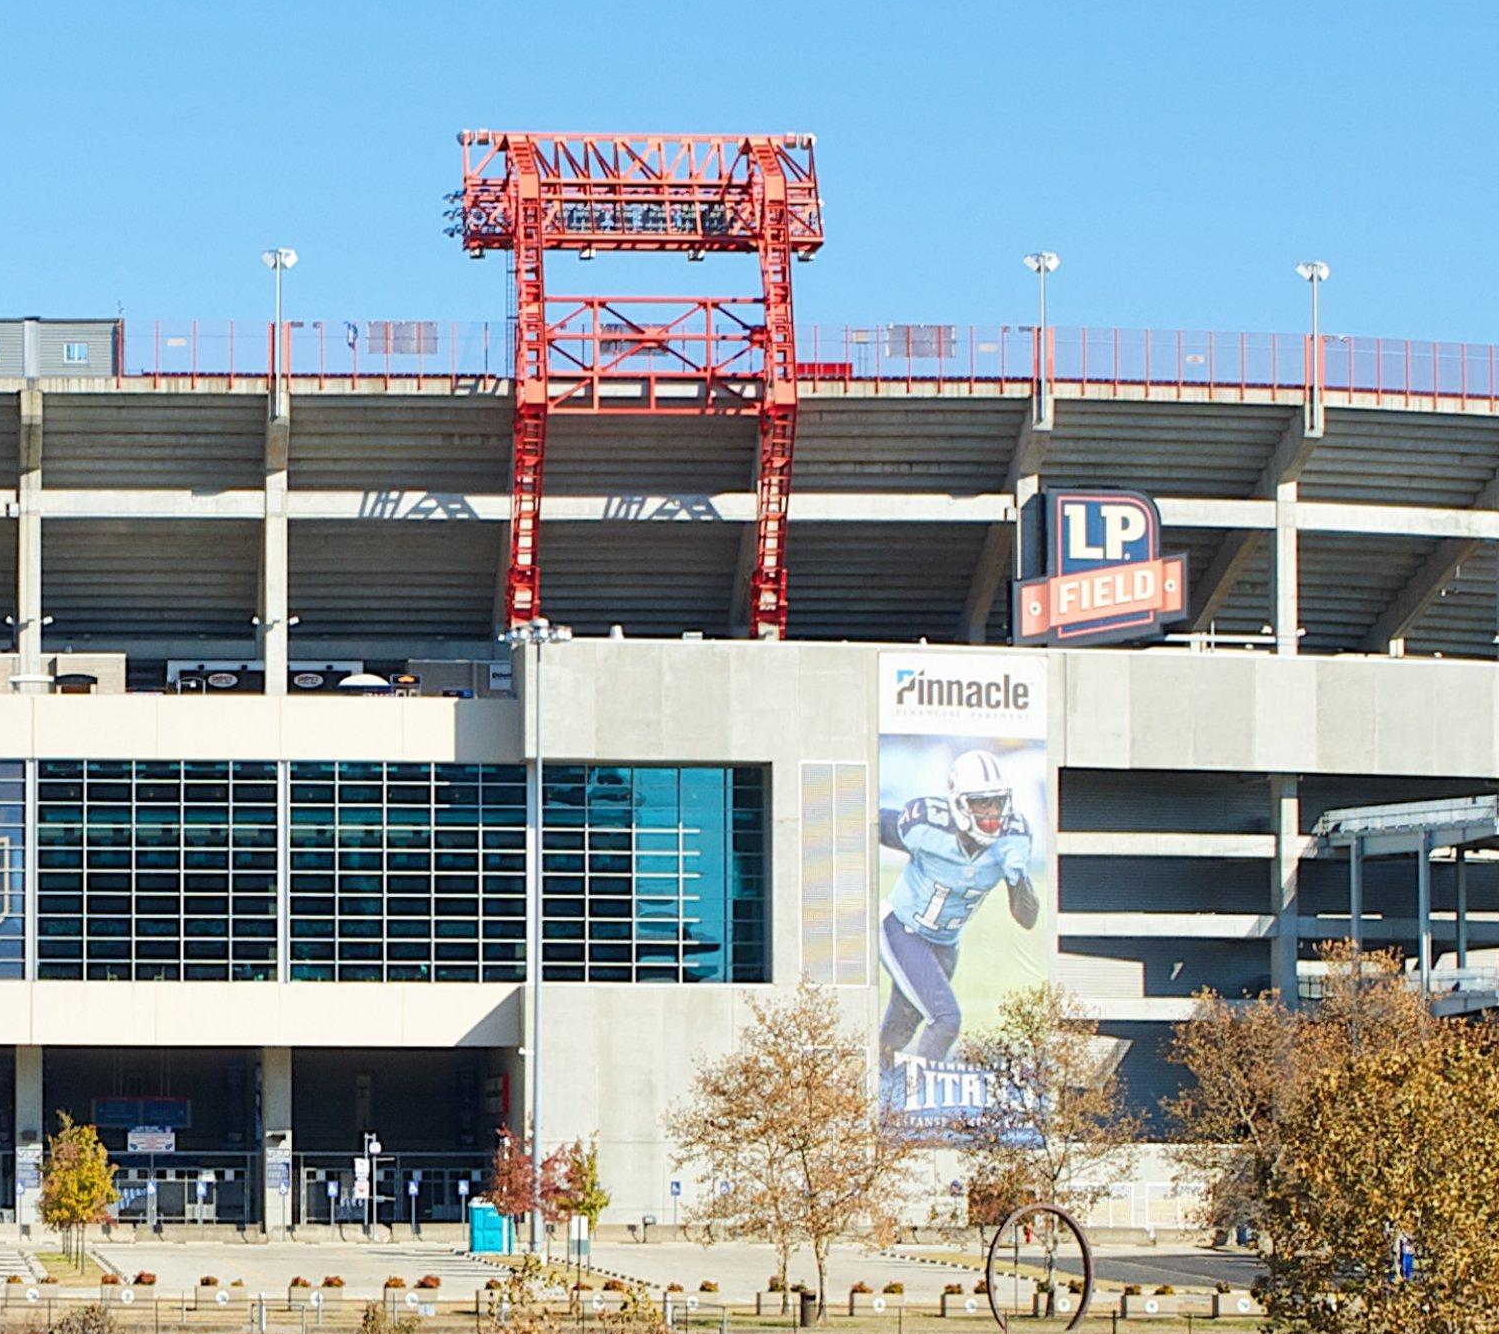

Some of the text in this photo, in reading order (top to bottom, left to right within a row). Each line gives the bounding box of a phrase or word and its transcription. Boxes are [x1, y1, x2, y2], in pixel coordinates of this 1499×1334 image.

[1063, 503, 1147, 560] LP
[1058, 569, 1156, 614] FIELD
[896, 669, 1030, 710] Pinnacle
